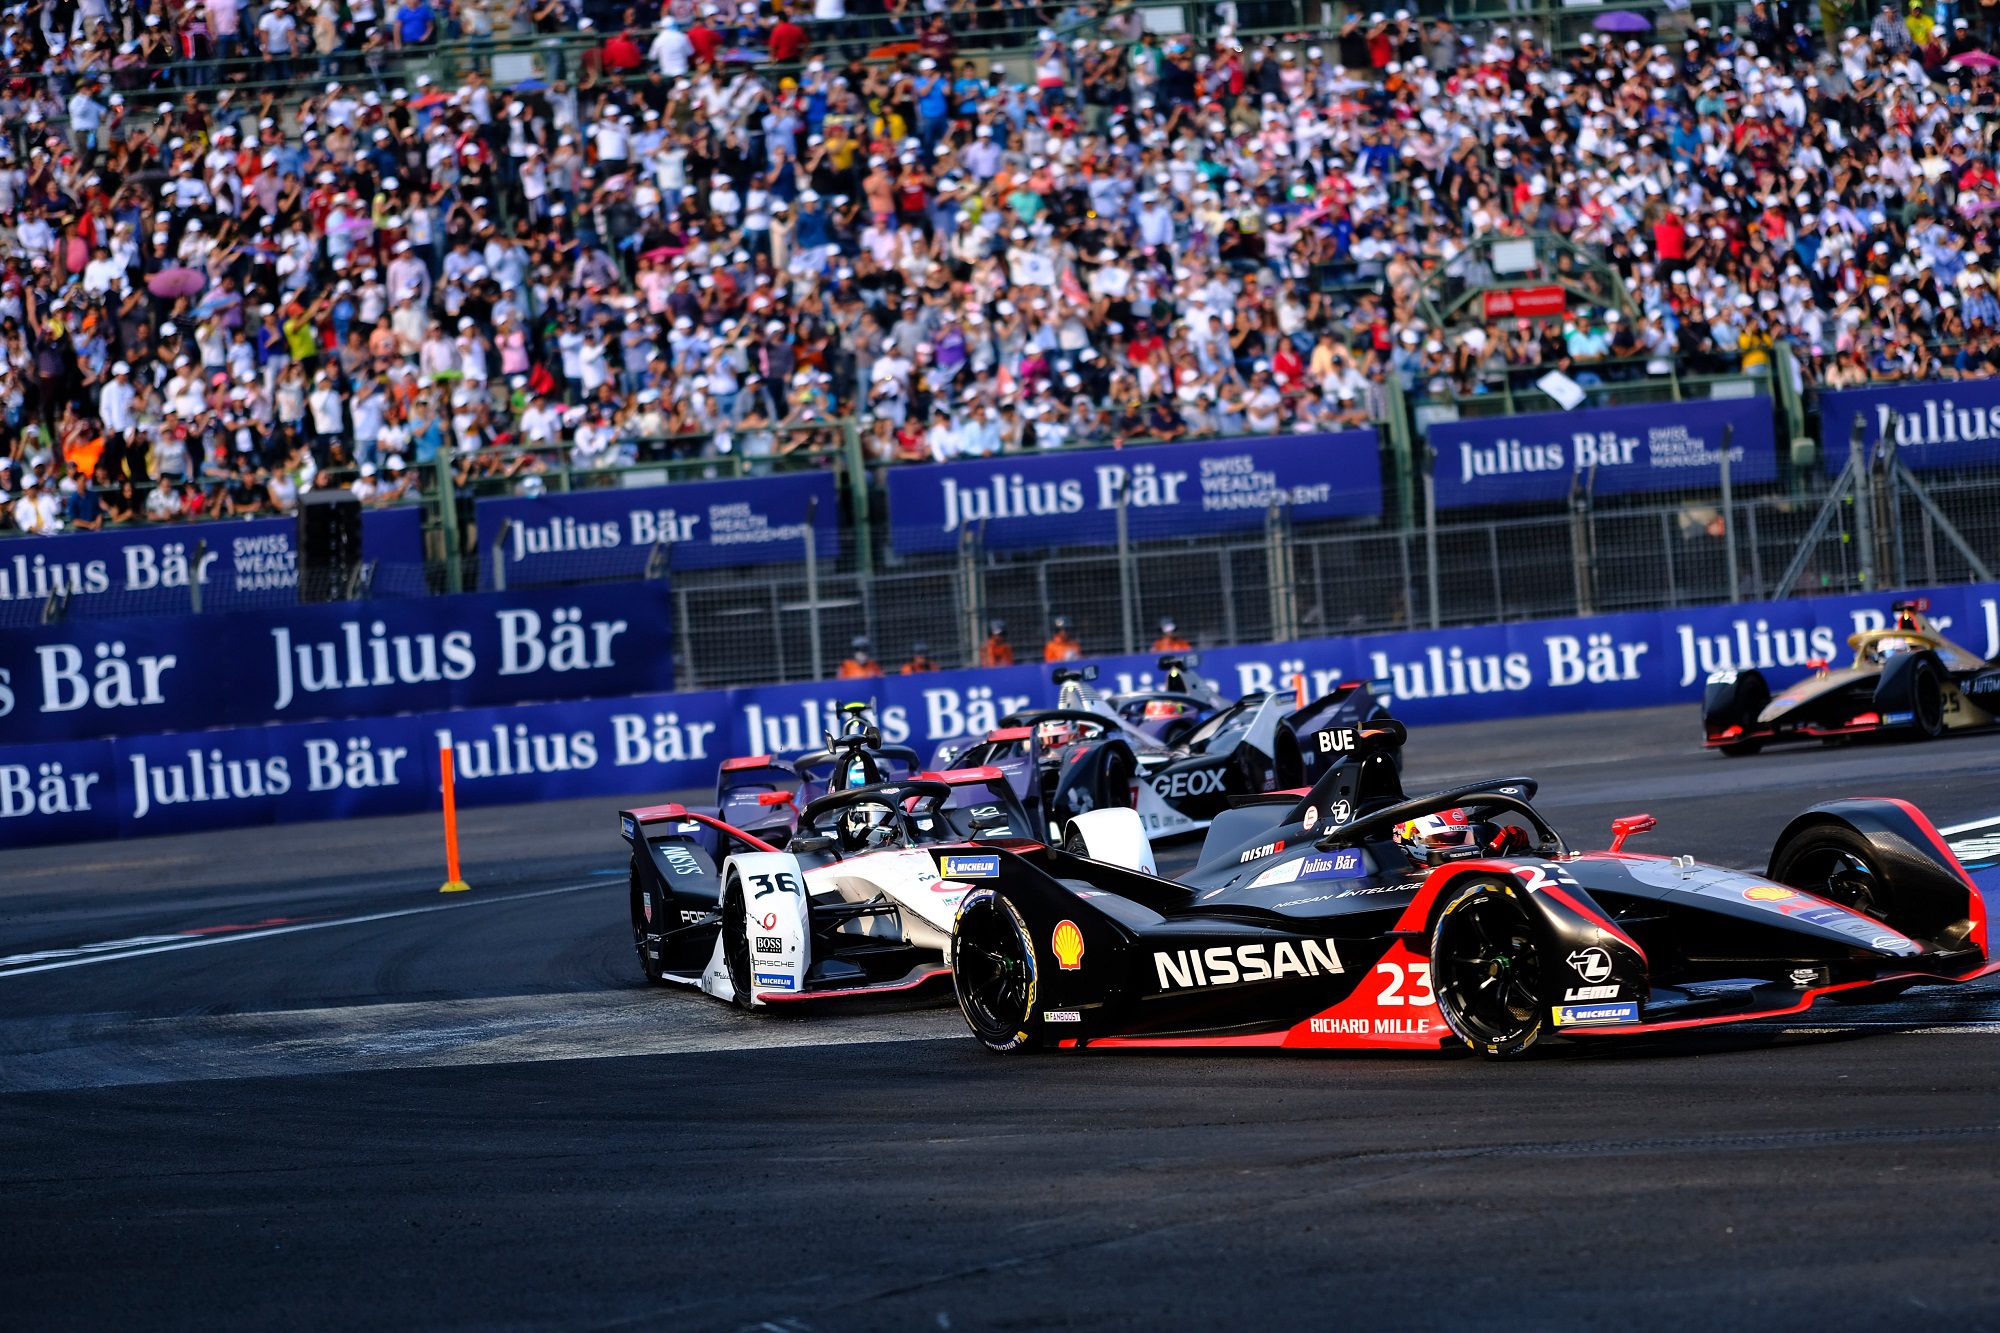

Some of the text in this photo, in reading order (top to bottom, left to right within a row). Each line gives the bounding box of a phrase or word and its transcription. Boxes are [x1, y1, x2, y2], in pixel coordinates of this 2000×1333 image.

[1648, 426, 1687, 441] SWISS
[1200, 456, 1254, 477] SWISS
[1460, 433, 1640, 483] Julius Bär
[1200, 471, 1275, 493] WEALTH
[941, 462, 1187, 533] Julius Bär
[233, 533, 288, 556] SWISS
[511, 509, 700, 562] Julius Bär
[123, 543, 219, 592] Bär
[233, 550, 297, 573] WEALT
[271, 606, 628, 710] Julius Bär
[1676, 618, 1837, 687] Julius
[35, 640, 177, 713] Bär
[1370, 632, 1648, 710] Julius Bär
[922, 686, 1031, 741] Bär
[611, 712, 715, 767] Bär
[1318, 729, 1355, 752] BUE
[0, 761, 99, 817] Bär
[129, 737, 407, 819] Julius Bär
[1151, 768, 1227, 798] GEOX
[957, 862, 994, 872] MICHELIN
[1301, 858, 1332, 877] Julius
[1334, 855, 1358, 871] Bär
[748, 872, 800, 900] 36
[1335, 882, 1424, 899] INTELLIGE
[757, 937, 781, 949] BOSS
[752, 959, 795, 968] ORSCHE
[1154, 938, 1345, 989] NISSAN
[762, 978, 792, 986] MICHELIN
[1376, 962, 1436, 1006] 23
[1564, 985, 1620, 1001] LEMO
[1310, 1018, 1430, 1034] RICHARD MILLE
[1576, 1008, 1631, 1019] MICHELIN
